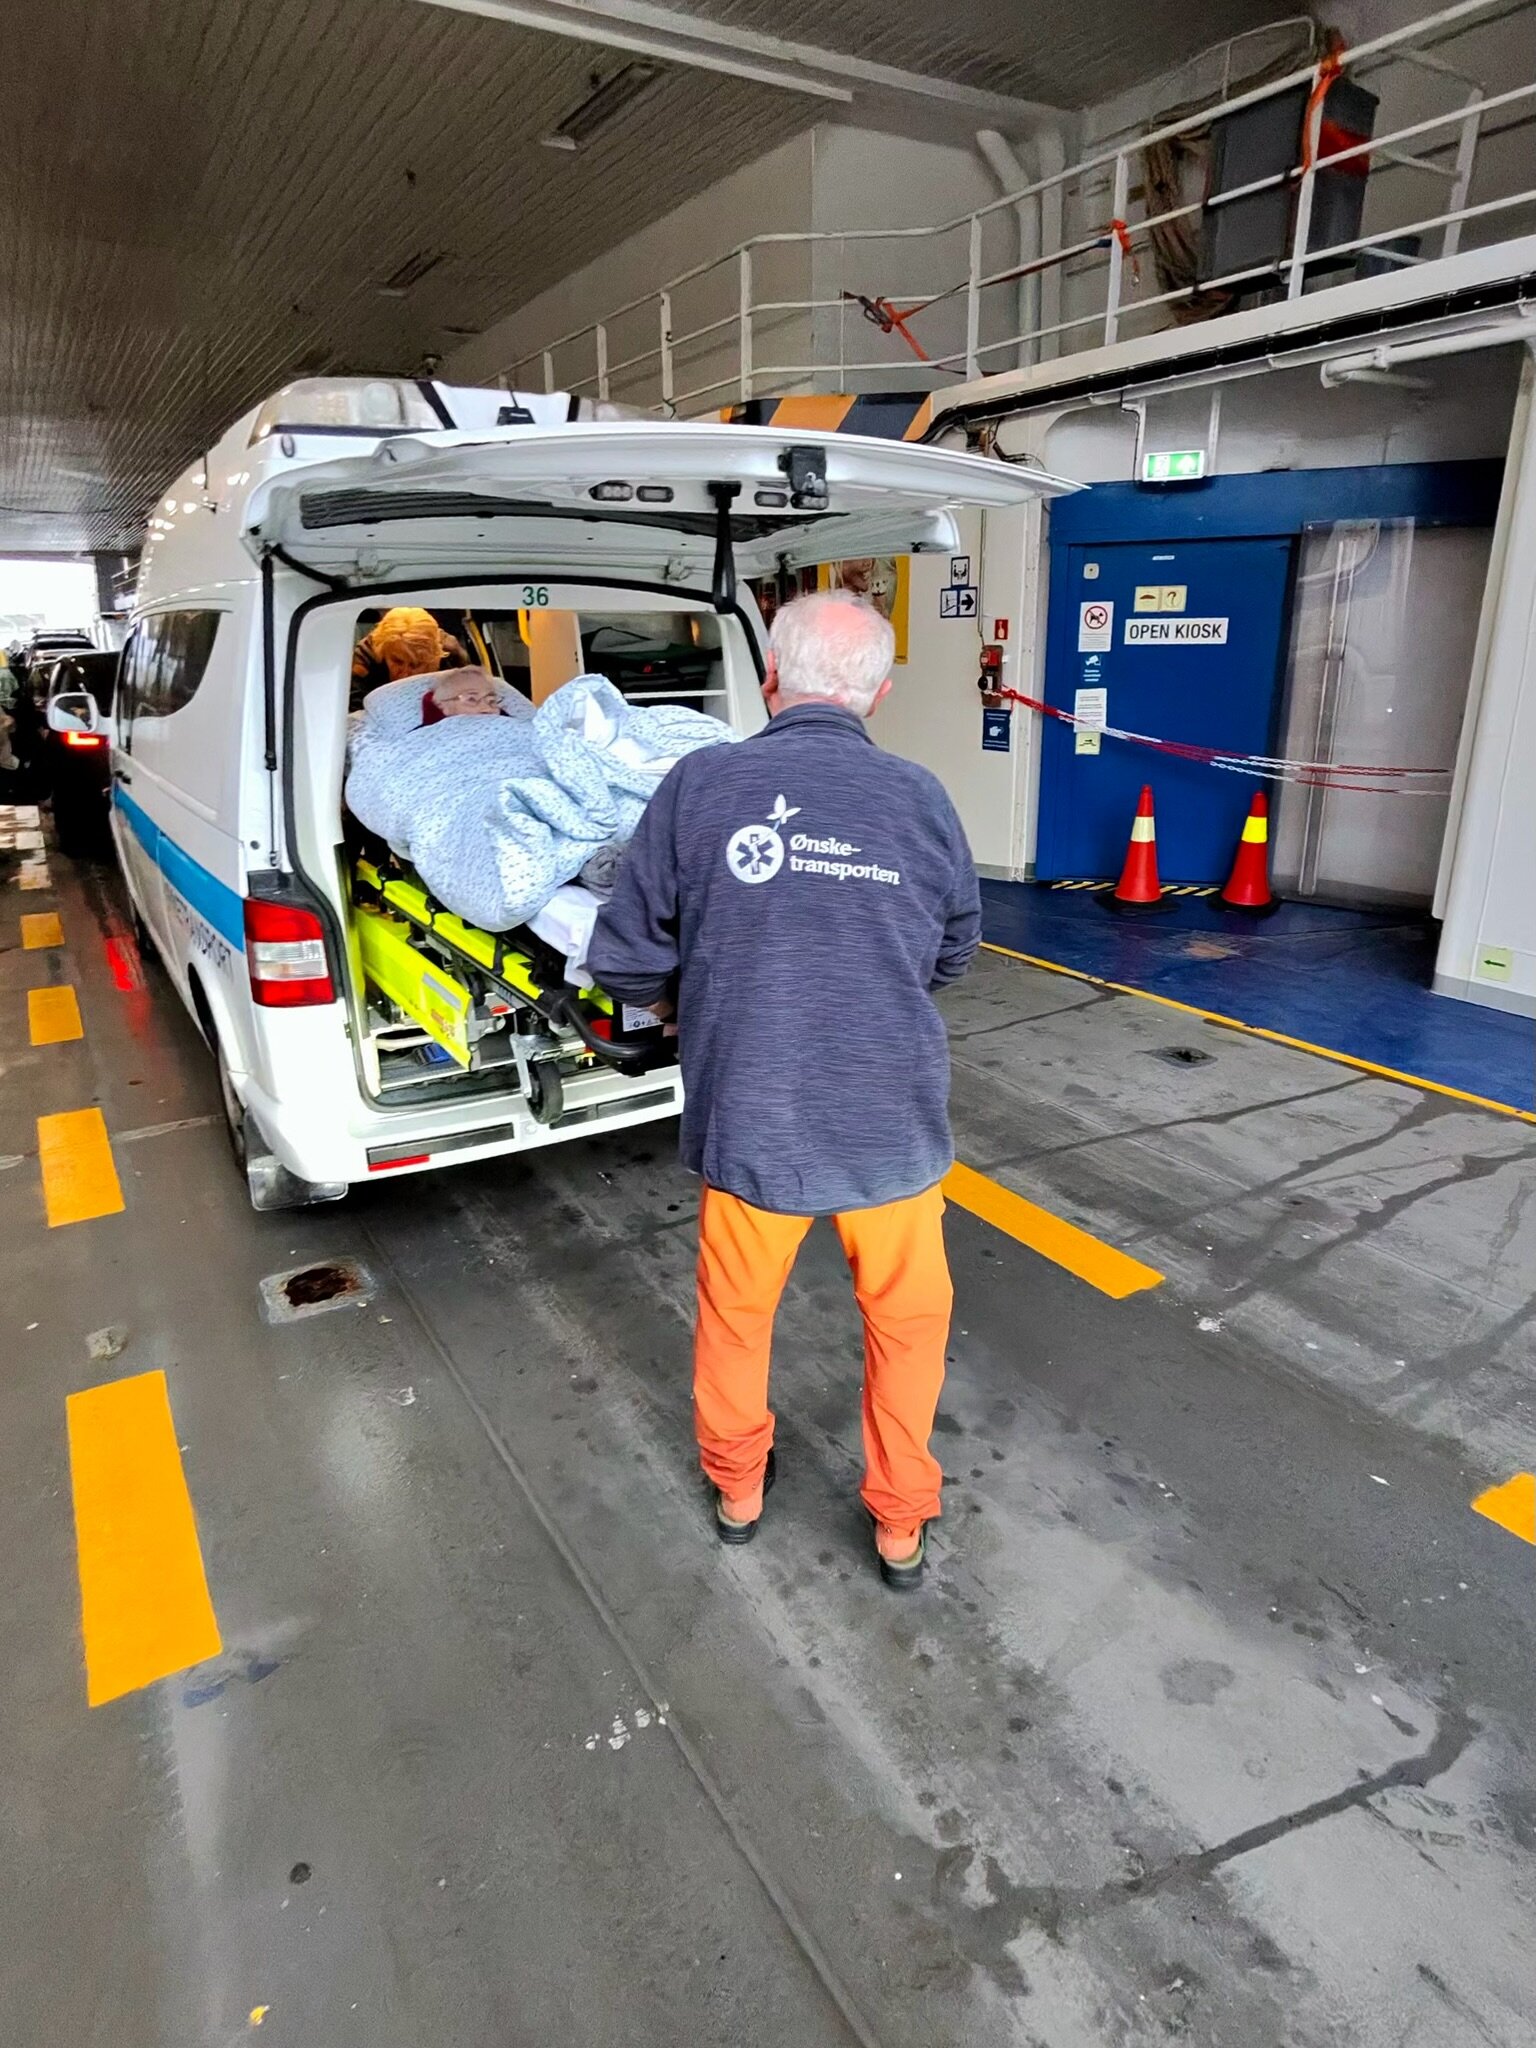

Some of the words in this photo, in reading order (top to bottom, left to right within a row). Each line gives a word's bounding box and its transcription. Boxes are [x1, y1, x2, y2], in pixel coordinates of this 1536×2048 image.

[522, 586, 549, 606] 36
[1129, 624, 1170, 639] OPEN
[1175, 623, 1222, 639] KIOSK
[789, 833, 862, 856] Ønske-
[789, 855, 901, 885] transporten
